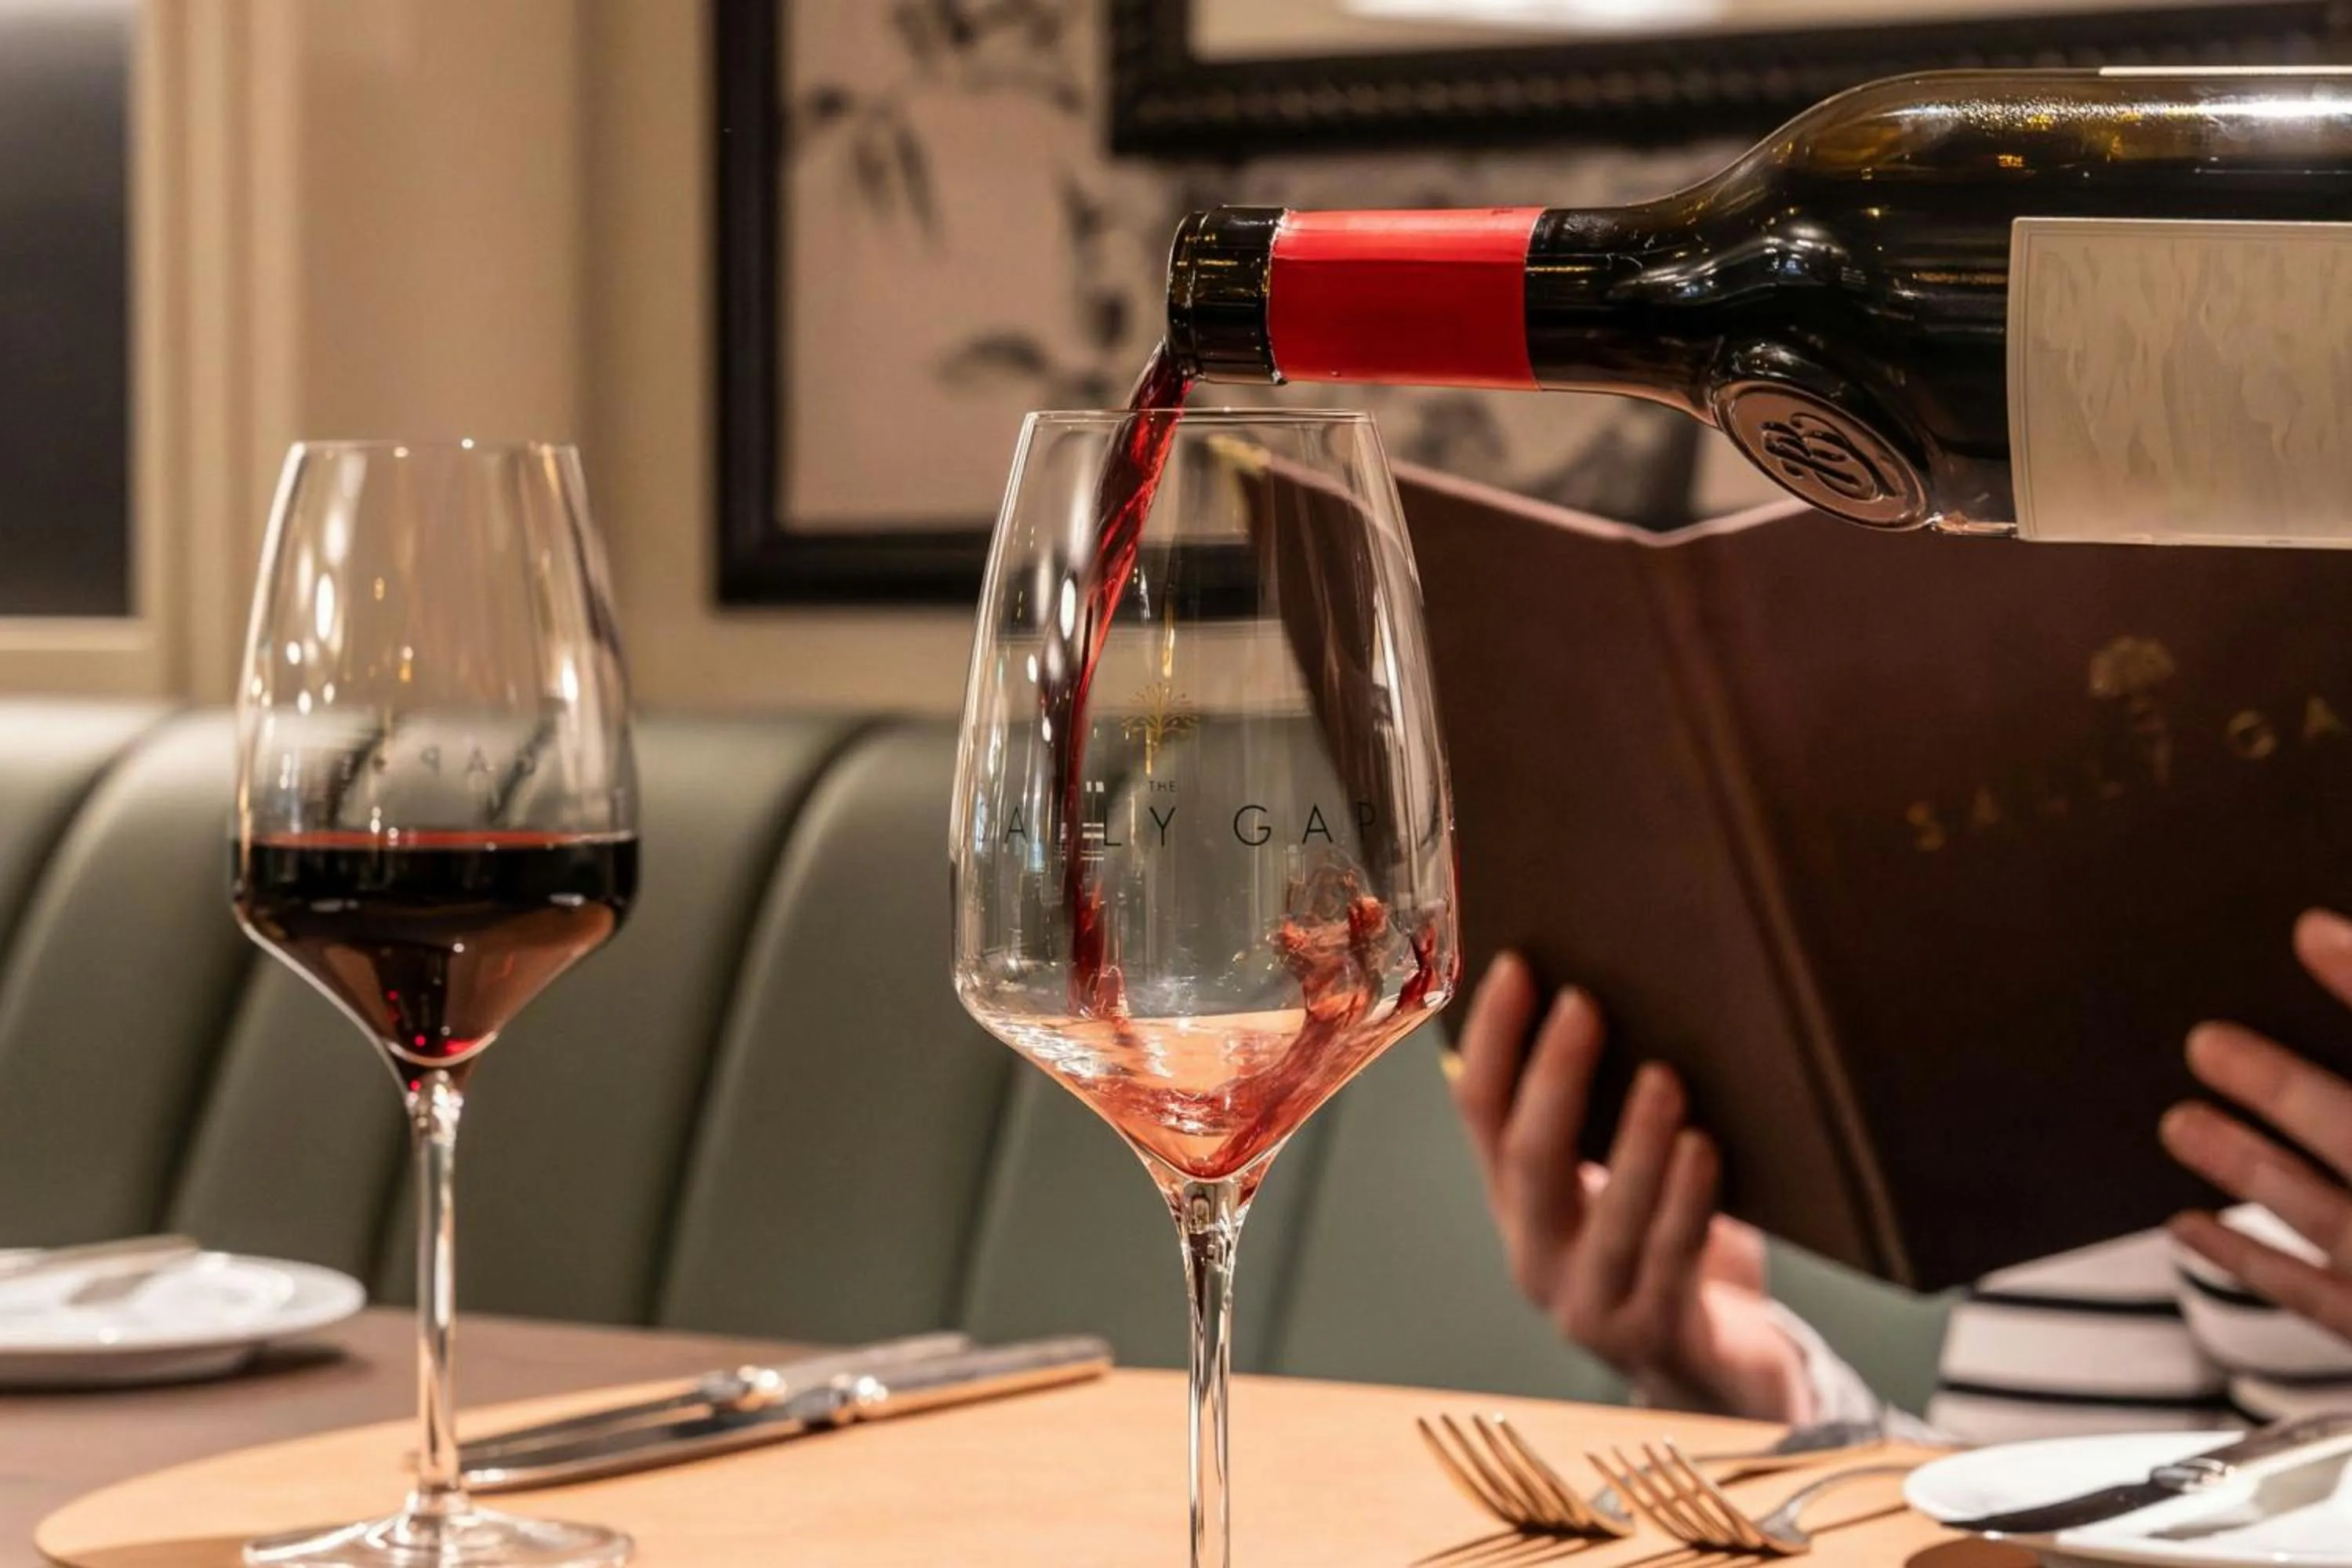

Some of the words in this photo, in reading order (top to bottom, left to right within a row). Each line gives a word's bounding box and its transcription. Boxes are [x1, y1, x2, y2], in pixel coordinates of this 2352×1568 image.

[1148, 779, 1177, 793] THE
[978, 801, 1176, 847] ALY
[1233, 801, 1377, 847] GAP
